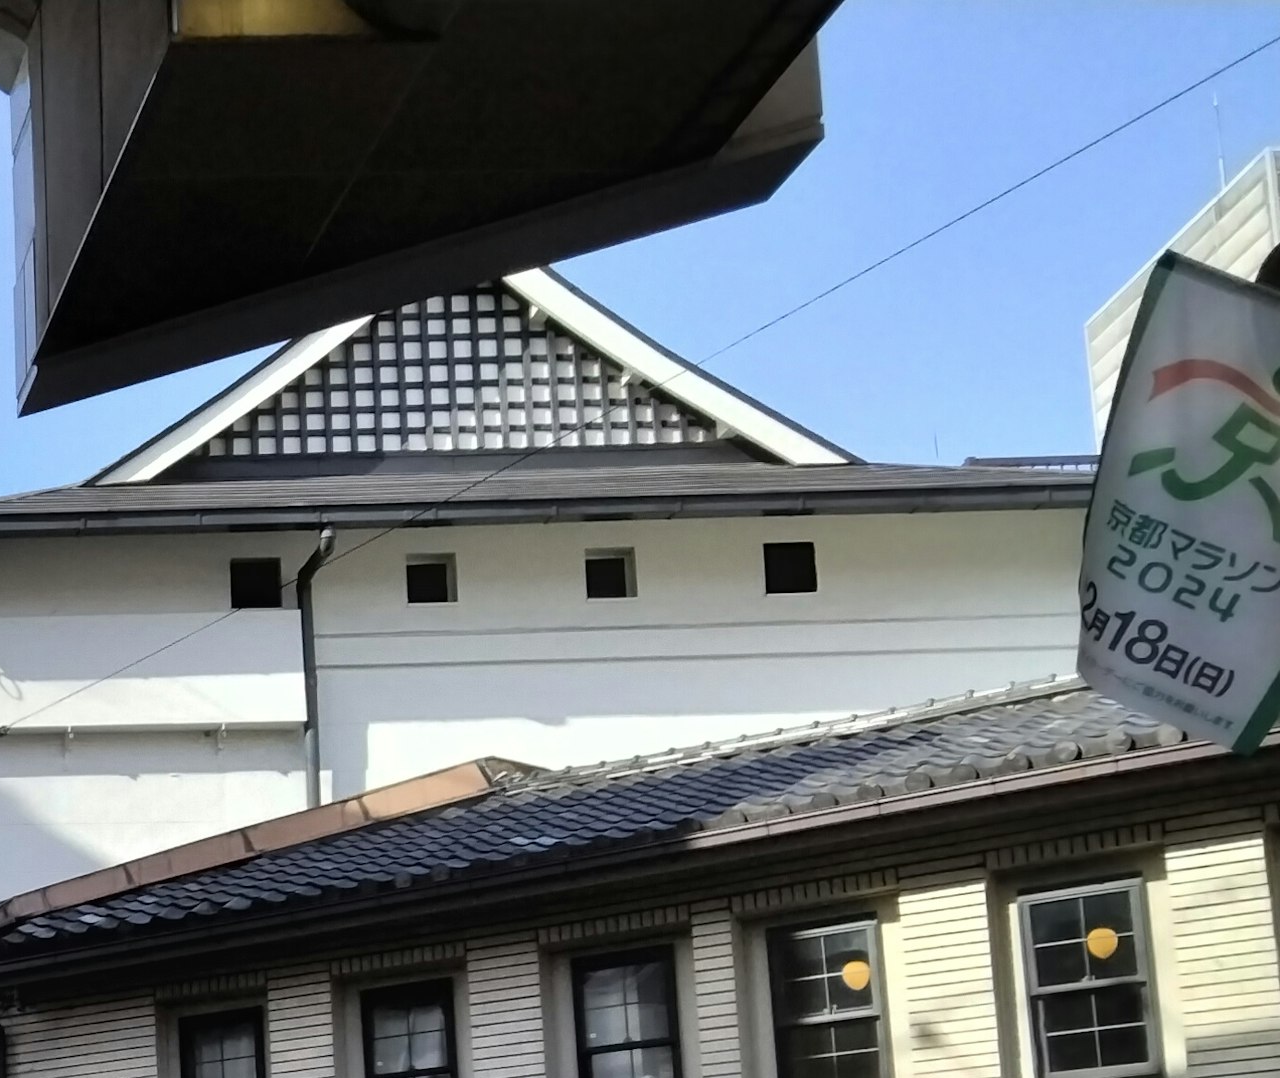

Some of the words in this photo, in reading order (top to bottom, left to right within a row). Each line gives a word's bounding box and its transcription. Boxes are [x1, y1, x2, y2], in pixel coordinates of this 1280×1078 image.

[1106, 499, 1280, 593] 京都マラソン
[1106, 543, 1242, 623] 2024
